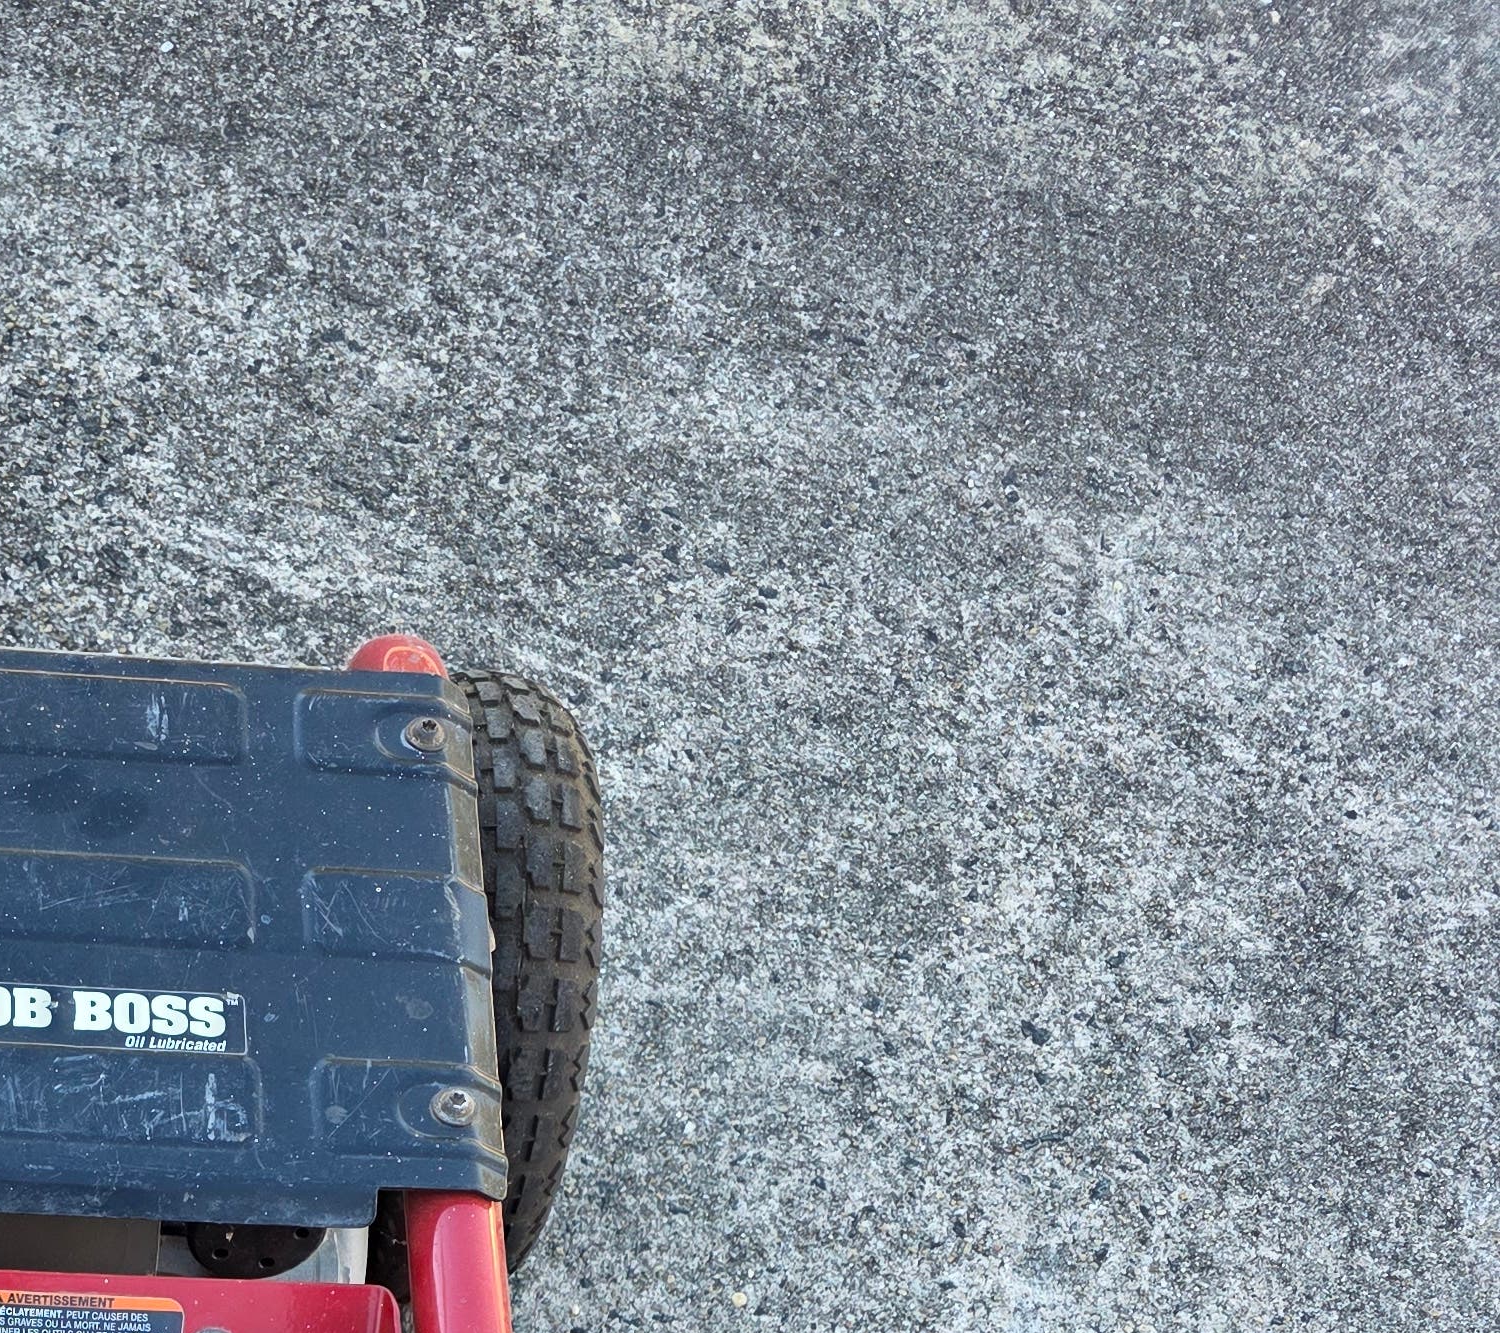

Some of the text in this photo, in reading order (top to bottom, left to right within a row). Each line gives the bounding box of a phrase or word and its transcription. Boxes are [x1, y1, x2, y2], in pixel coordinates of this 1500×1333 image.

[72, 990, 226, 1038] BOSS
[125, 1036, 226, 1052] Oil Lubricated
[8, 1293, 114, 1308] AVERTISSEMENT
[67, 1311, 89, 1320] PEUT
[93, 1312, 129, 1321] CAUSER
[132, 1313, 148, 1322] DES
[8, 1318, 43, 1326] GRAVES
[46, 1320, 58, 1328] OU
[60, 1320, 72, 1328] LA
[74, 1321, 101, 1330] MORT.
[118, 1323, 151, 1332] JAMAIS
